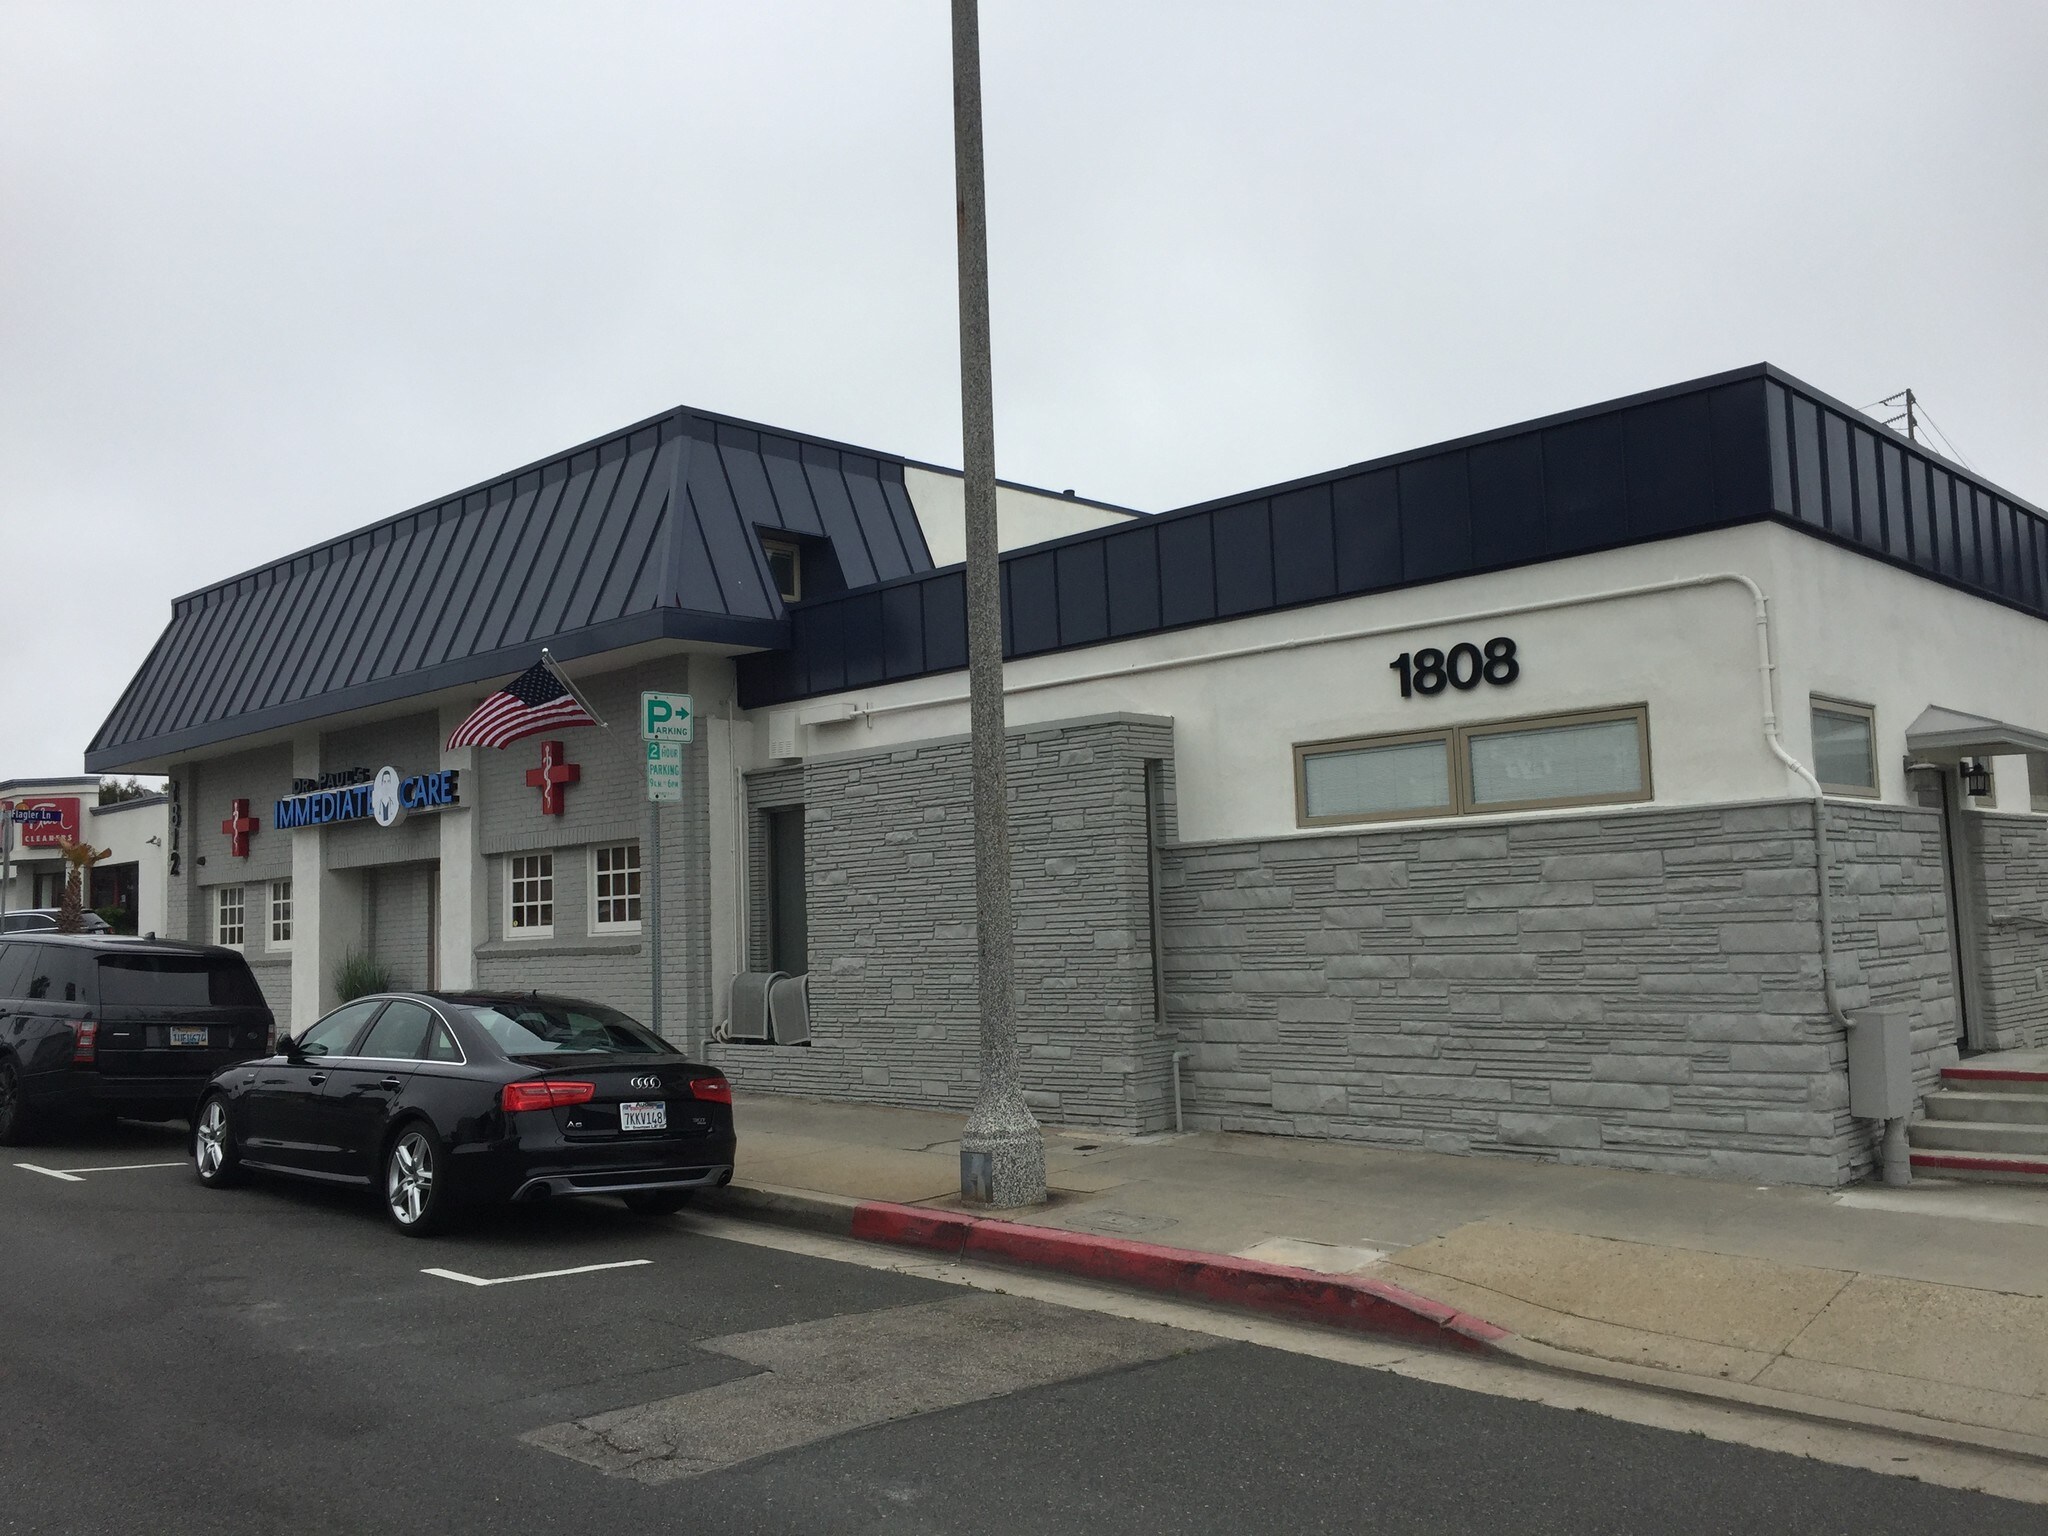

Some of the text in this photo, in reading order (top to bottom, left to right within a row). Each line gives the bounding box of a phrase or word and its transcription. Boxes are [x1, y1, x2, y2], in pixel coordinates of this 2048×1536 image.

[1389, 636, 1520, 698] 1808
[650, 744, 679, 758] 2 HOUR
[650, 764, 679, 776] PARKING
[274, 770, 453, 829] IMMEDIATE CARE
[11, 810, 51, 820] Flagler Ln
[624, 1112, 663, 1126] 7KKV148
